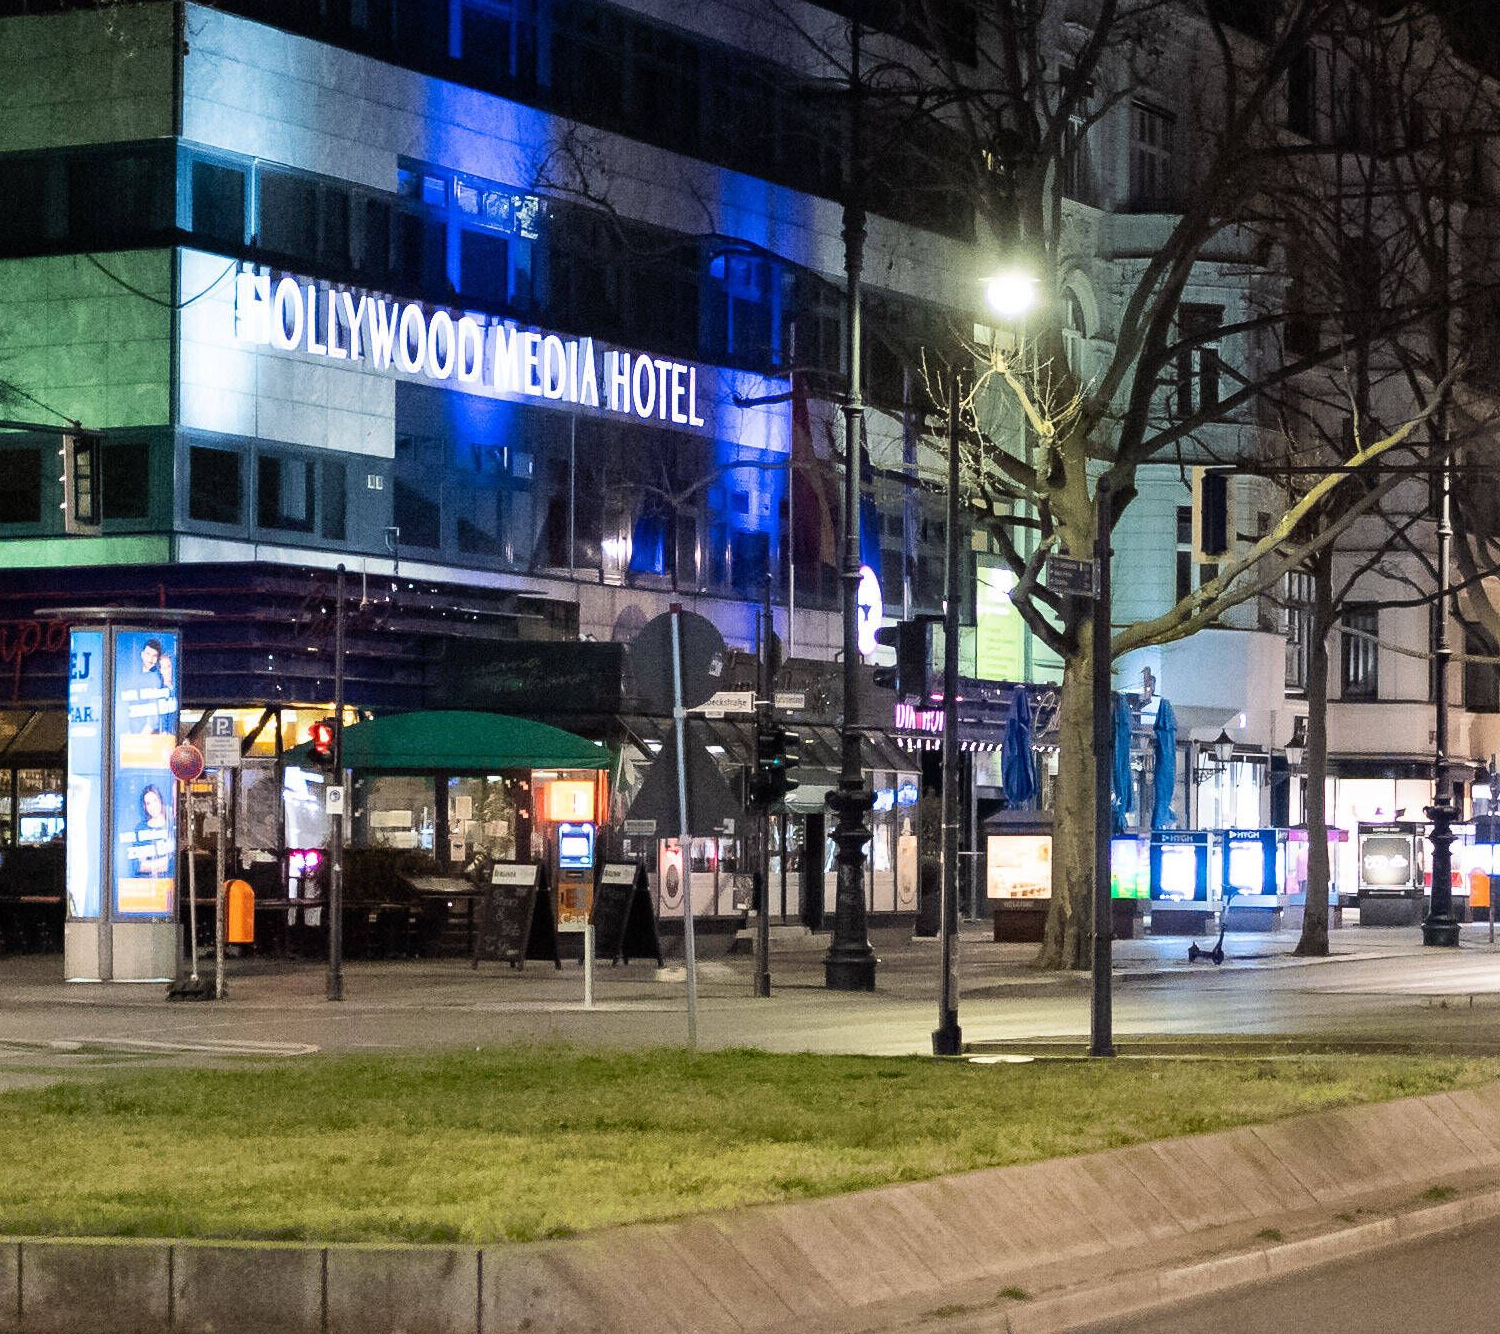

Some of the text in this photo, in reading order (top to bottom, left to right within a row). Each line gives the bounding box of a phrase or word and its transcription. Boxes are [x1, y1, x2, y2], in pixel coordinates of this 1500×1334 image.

[242, 272, 705, 427] HOLLYWOOD MEDIA HOTEL
[216, 718, 229, 736] P
